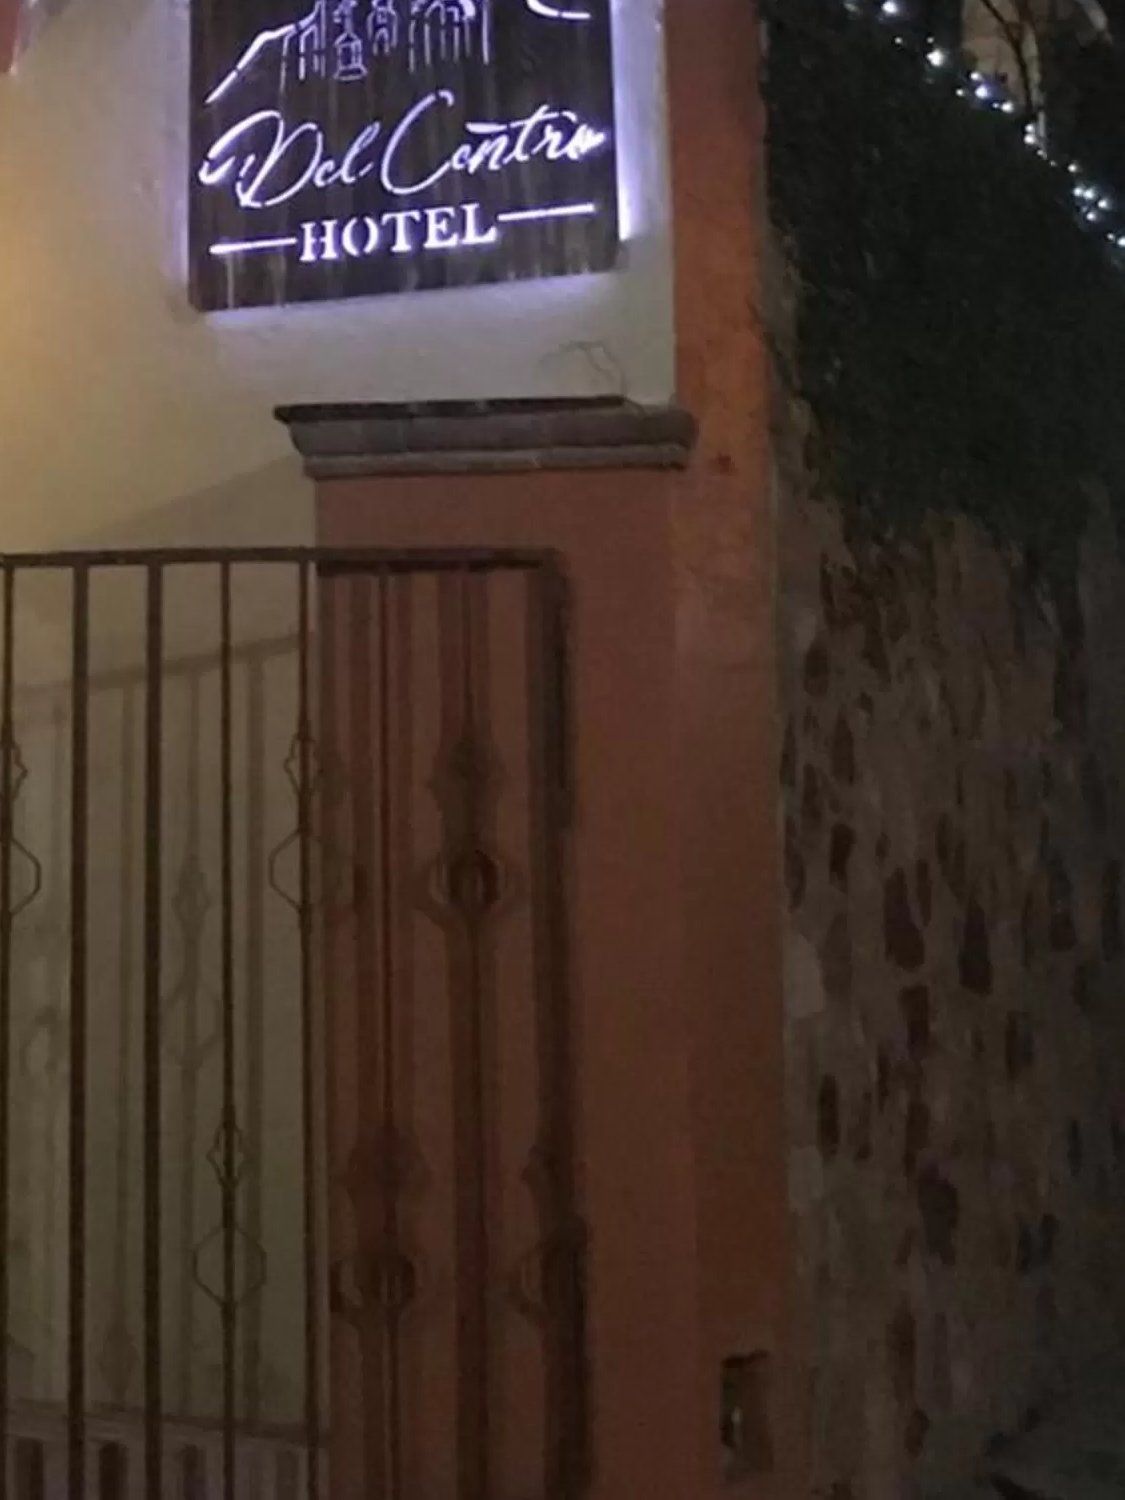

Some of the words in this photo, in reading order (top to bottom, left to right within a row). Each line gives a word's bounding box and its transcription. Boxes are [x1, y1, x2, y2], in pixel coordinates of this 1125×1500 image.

[198, 109, 381, 208] Del
[382, 89, 606, 195] Centro
[298, 202, 498, 262] HOTEL
